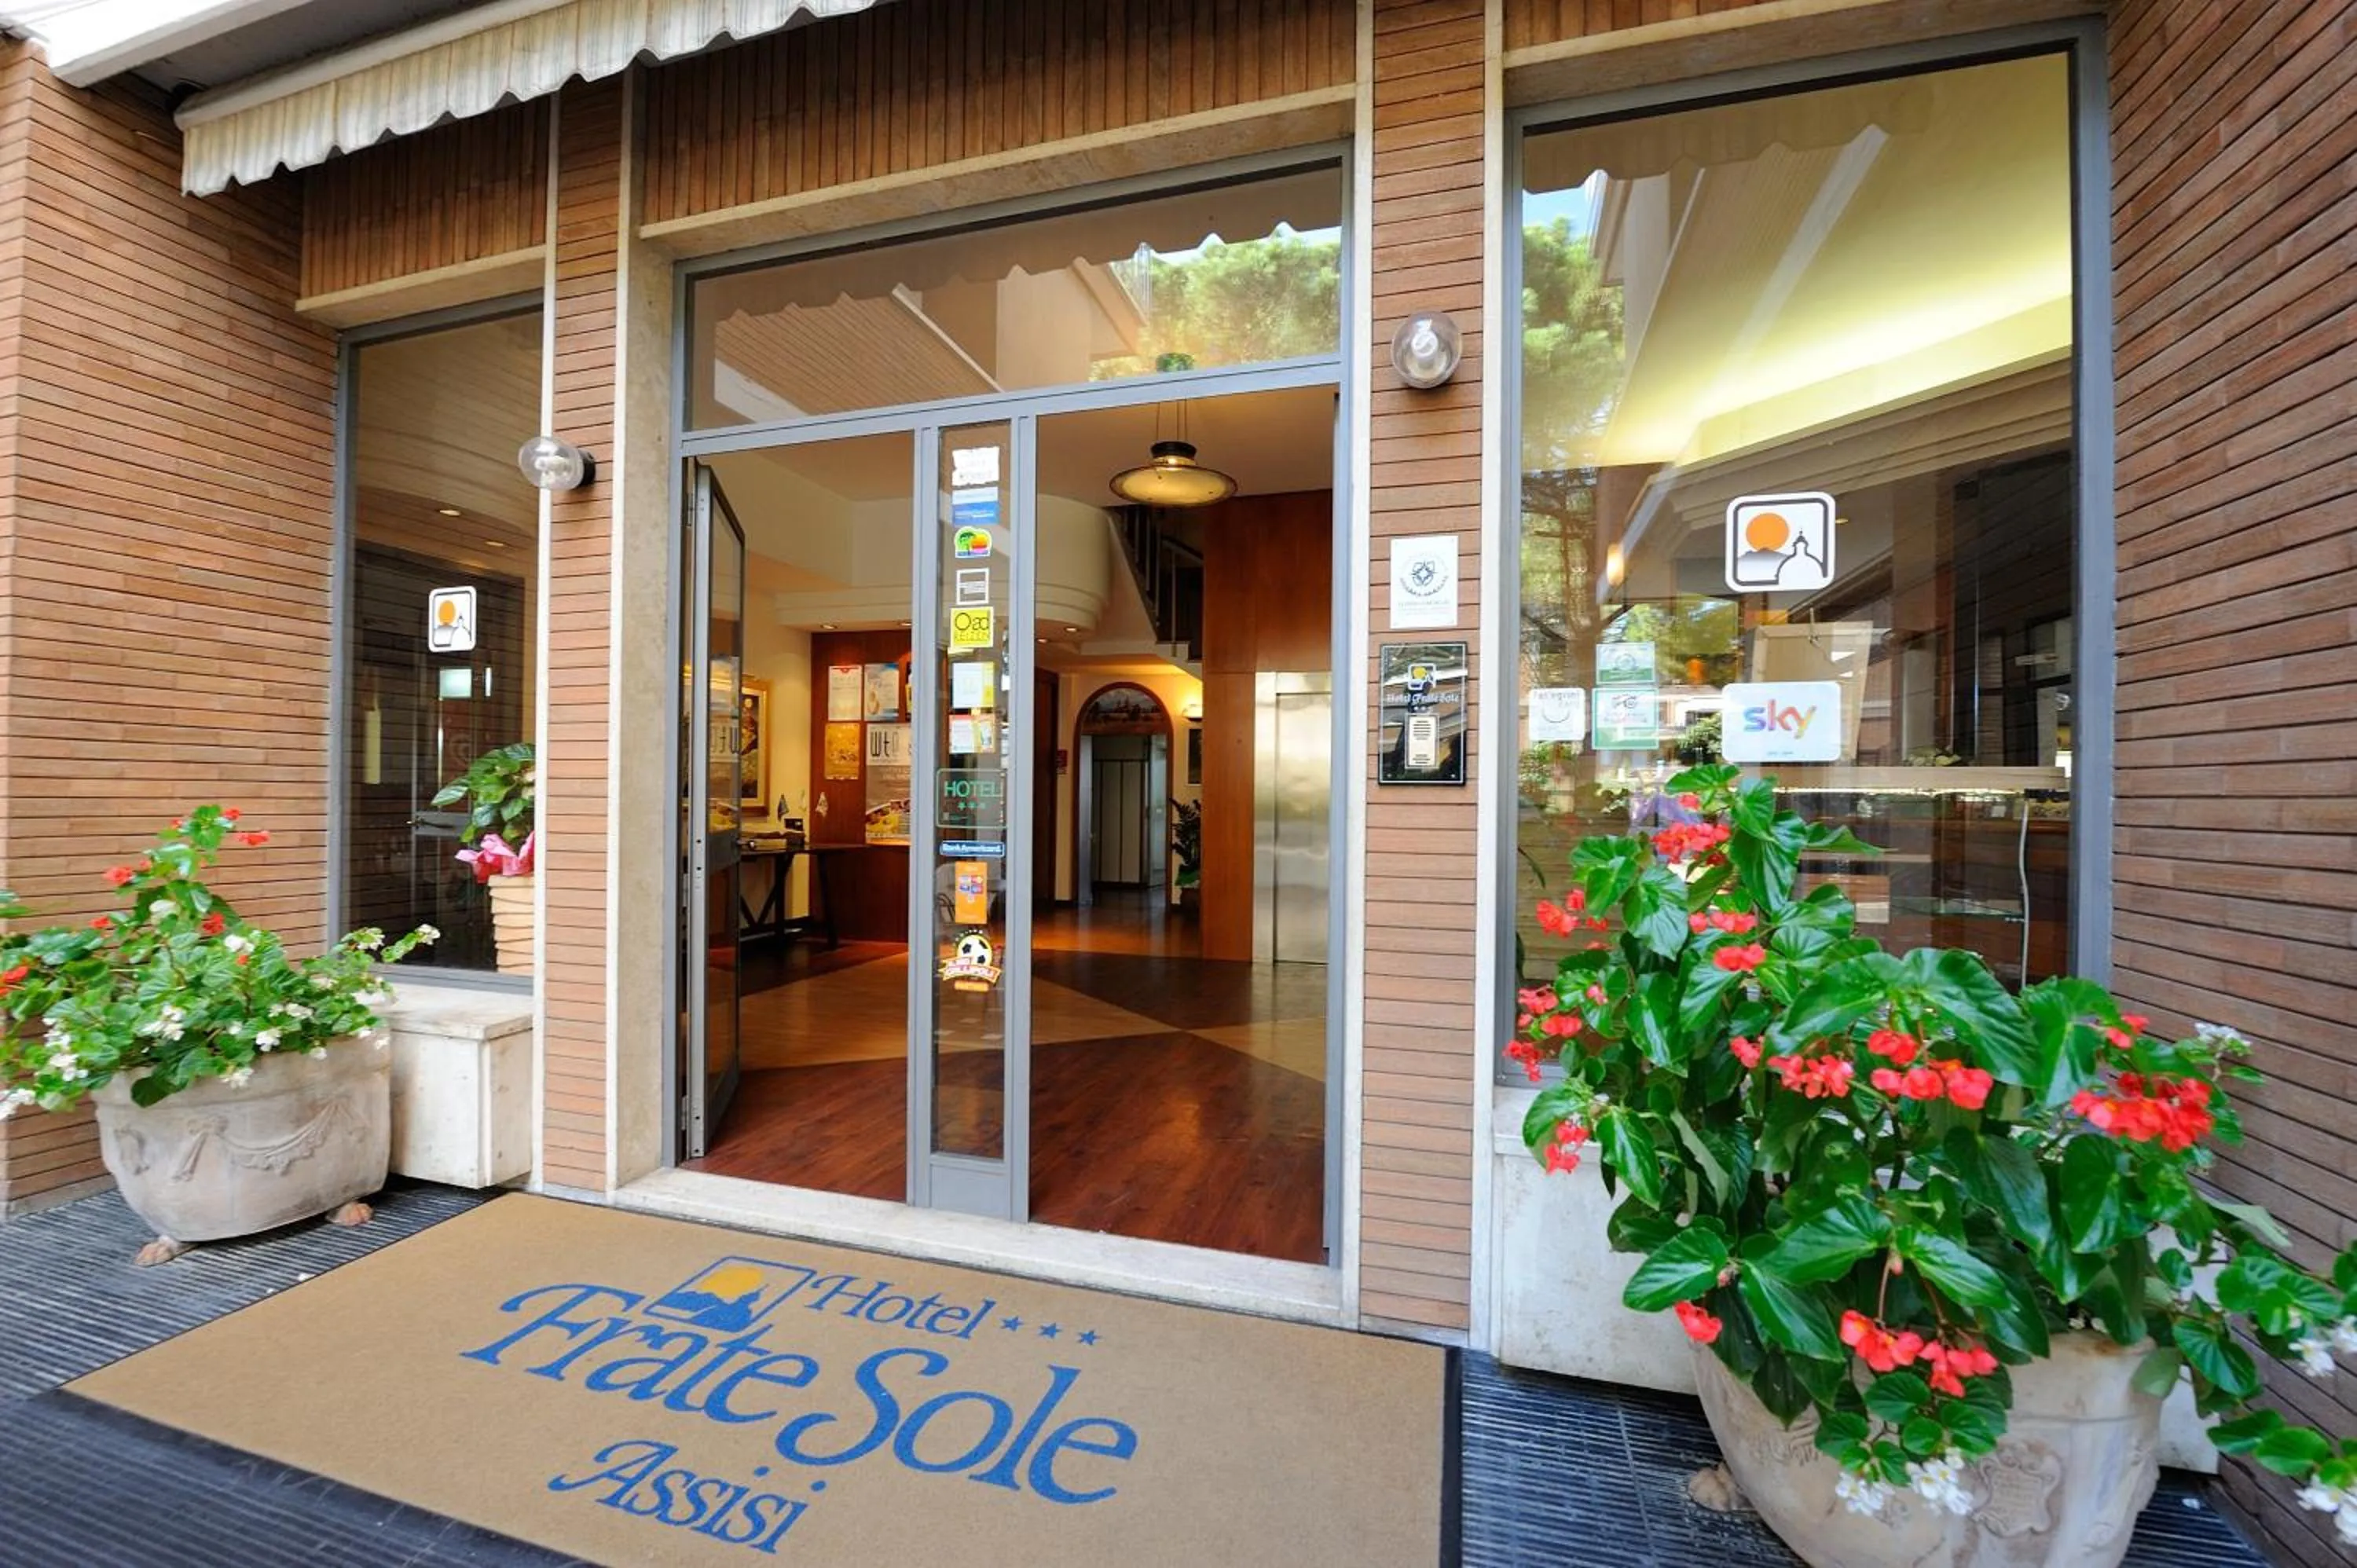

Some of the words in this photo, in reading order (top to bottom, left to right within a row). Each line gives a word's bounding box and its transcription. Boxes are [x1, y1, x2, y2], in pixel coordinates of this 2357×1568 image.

[1743, 698, 1817, 740] sky
[944, 780, 1003, 797] HOTEL
[808, 1275, 995, 1340] Hotel
[459, 1283, 820, 1424] Frate
[775, 1346, 1138, 1506] Sole
[547, 1439, 829, 1555] Assisi
